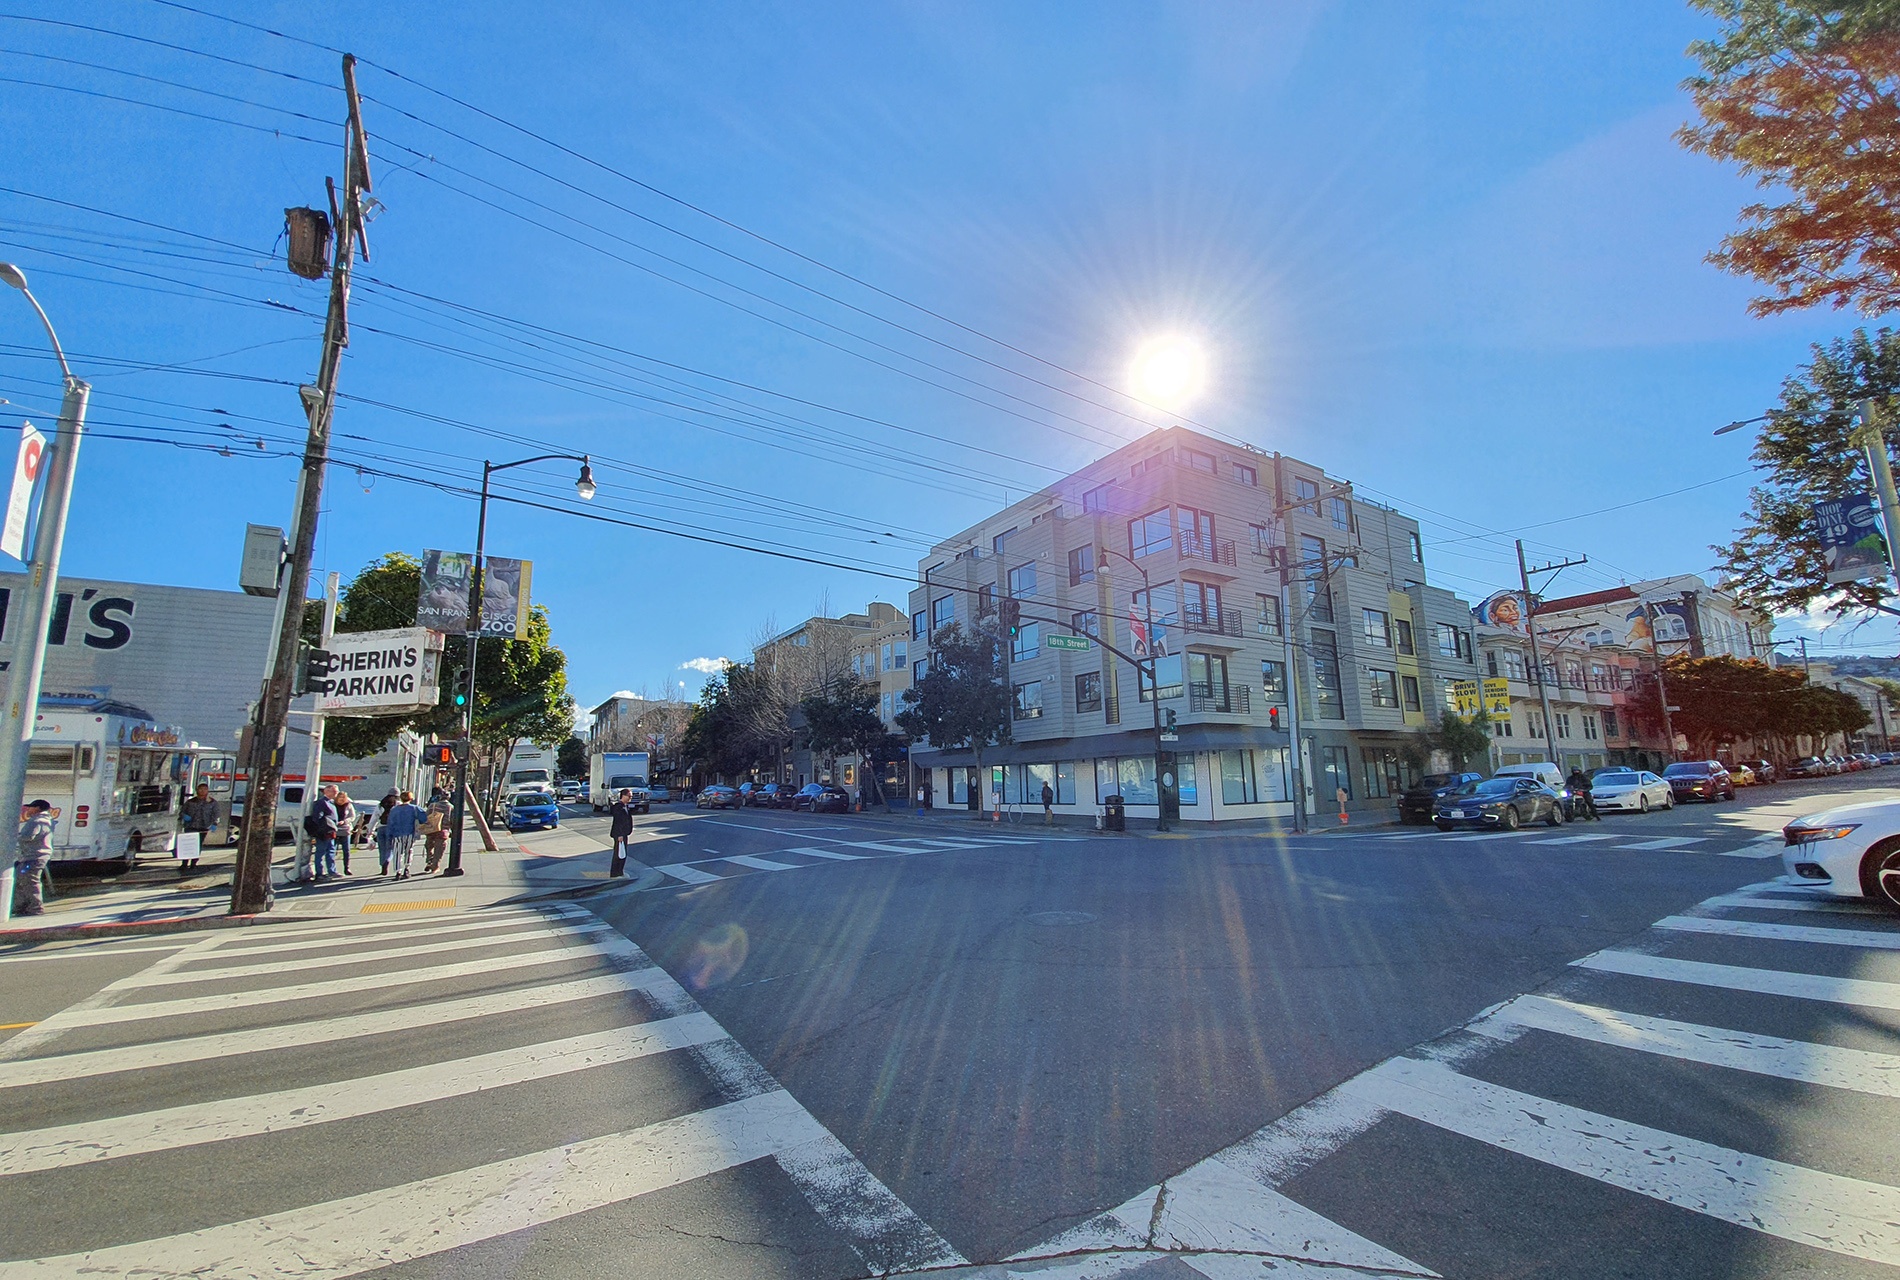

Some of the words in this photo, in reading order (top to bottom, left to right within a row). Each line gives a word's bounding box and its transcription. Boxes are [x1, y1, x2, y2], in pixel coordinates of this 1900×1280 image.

[1815, 502, 1842, 516] SHOP
[1818, 512, 1844, 528] DINE
[1821, 524, 1848, 538] 49
[418, 606, 440, 615] SAN
[481, 612, 517, 622] CISCO
[481, 620, 517, 633] ZOO
[1049, 637, 1064, 646] 18th
[1067, 640, 1087, 648] Street
[328, 645, 417, 673] CHERIN'S
[323, 674, 414, 698] PARKING
[1455, 689, 1477, 697] SLOW
